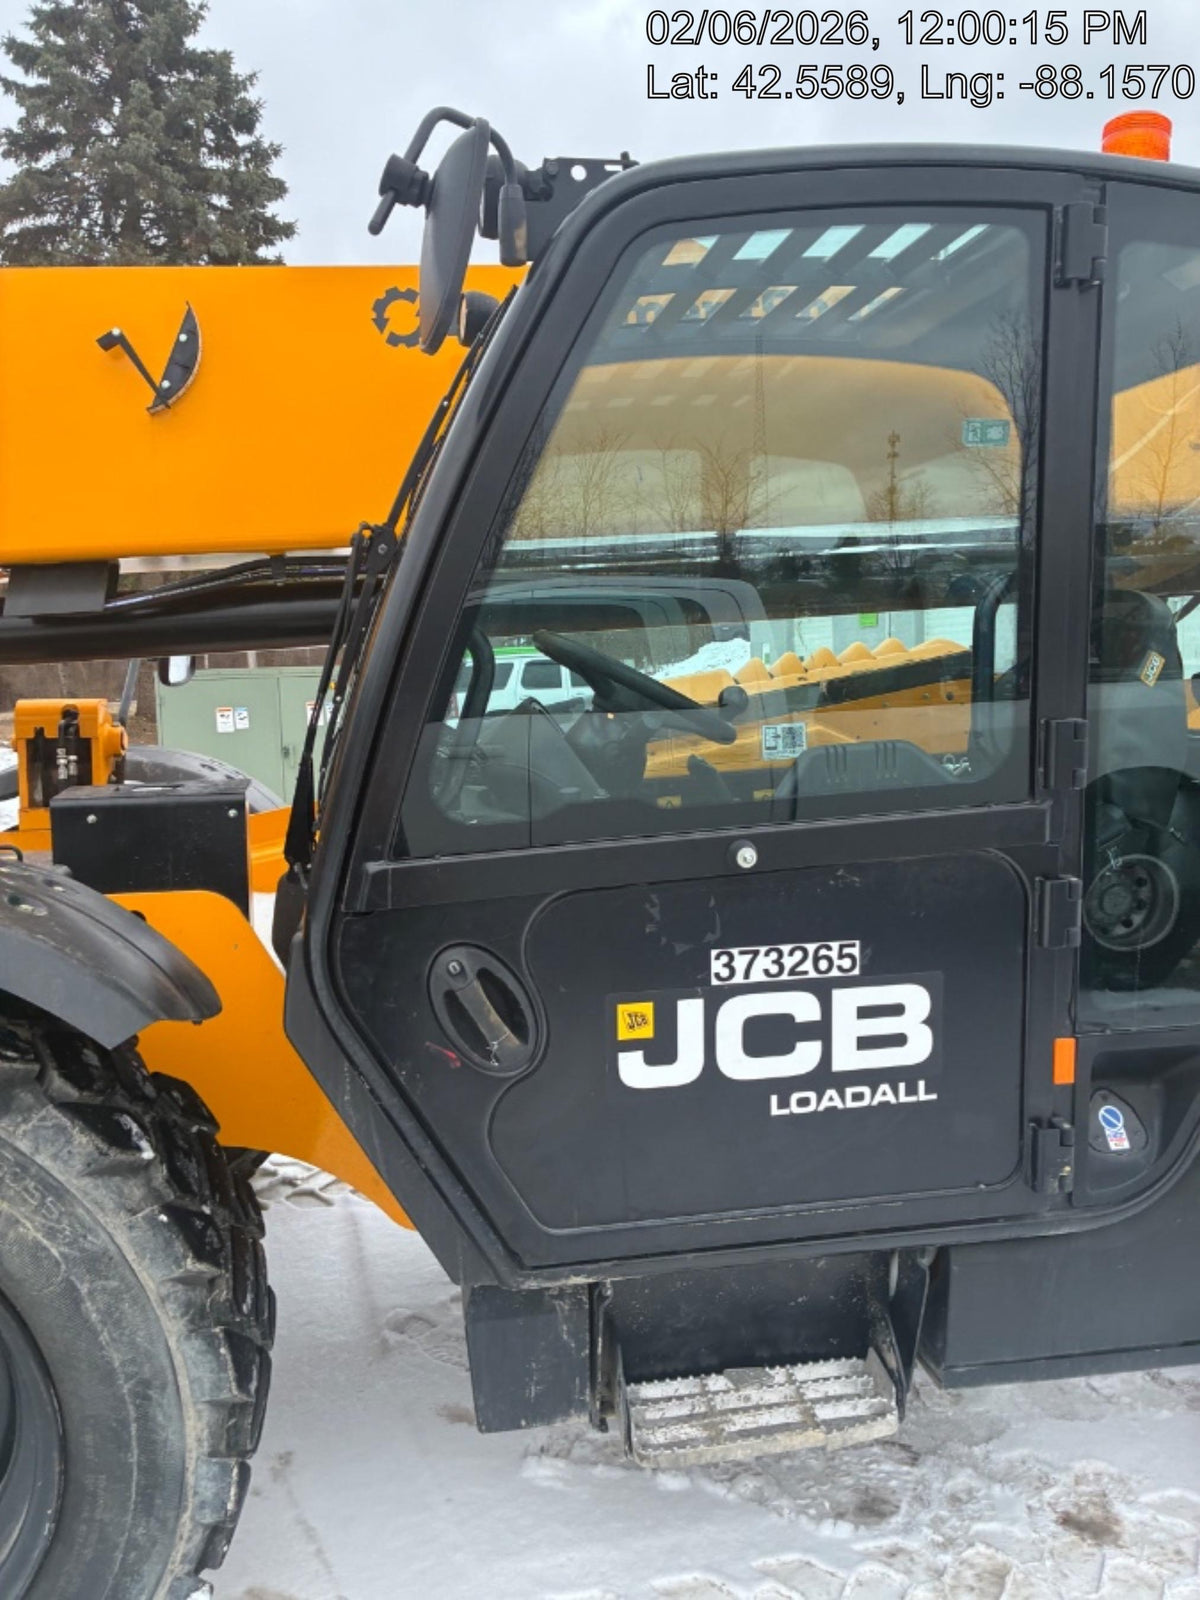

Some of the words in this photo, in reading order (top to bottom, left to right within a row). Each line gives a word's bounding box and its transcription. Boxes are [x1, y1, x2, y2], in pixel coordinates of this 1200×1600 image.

[713, 943, 858, 982] 373265
[617, 983, 934, 1089] JCB
[625, 1010, 648, 1031] JCB
[770, 1080, 938, 1116] LOADALL
